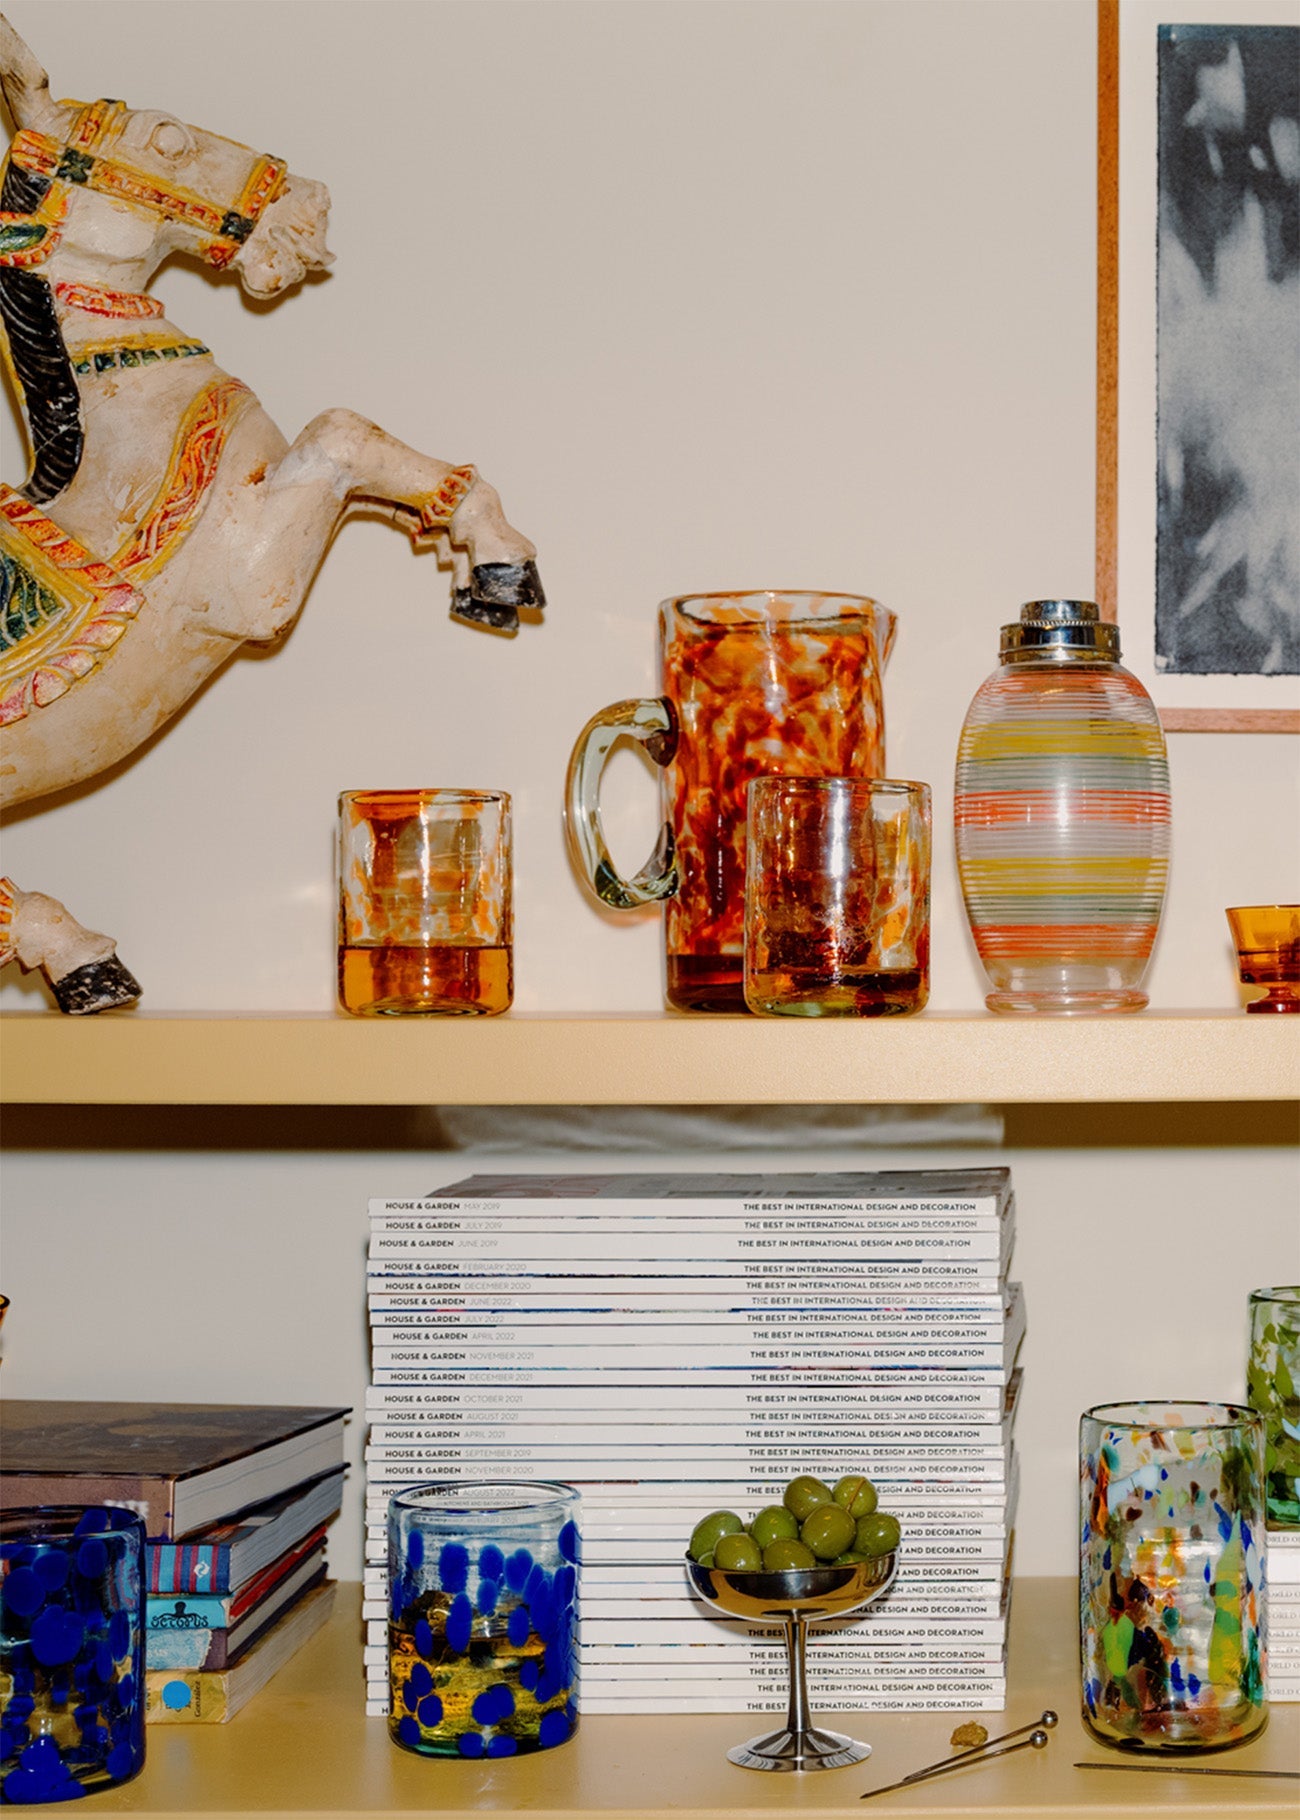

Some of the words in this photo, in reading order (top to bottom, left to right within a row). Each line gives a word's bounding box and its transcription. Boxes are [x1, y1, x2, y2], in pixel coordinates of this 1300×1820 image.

[492, 1298, 512, 1306] 2022
[495, 1332, 515, 1340] 2022
[516, 1352, 534, 1360] 2021
[515, 1373, 533, 1381] 2021
[463, 1395, 504, 1403] OCTOBER
[513, 1466, 534, 1474] 2020
